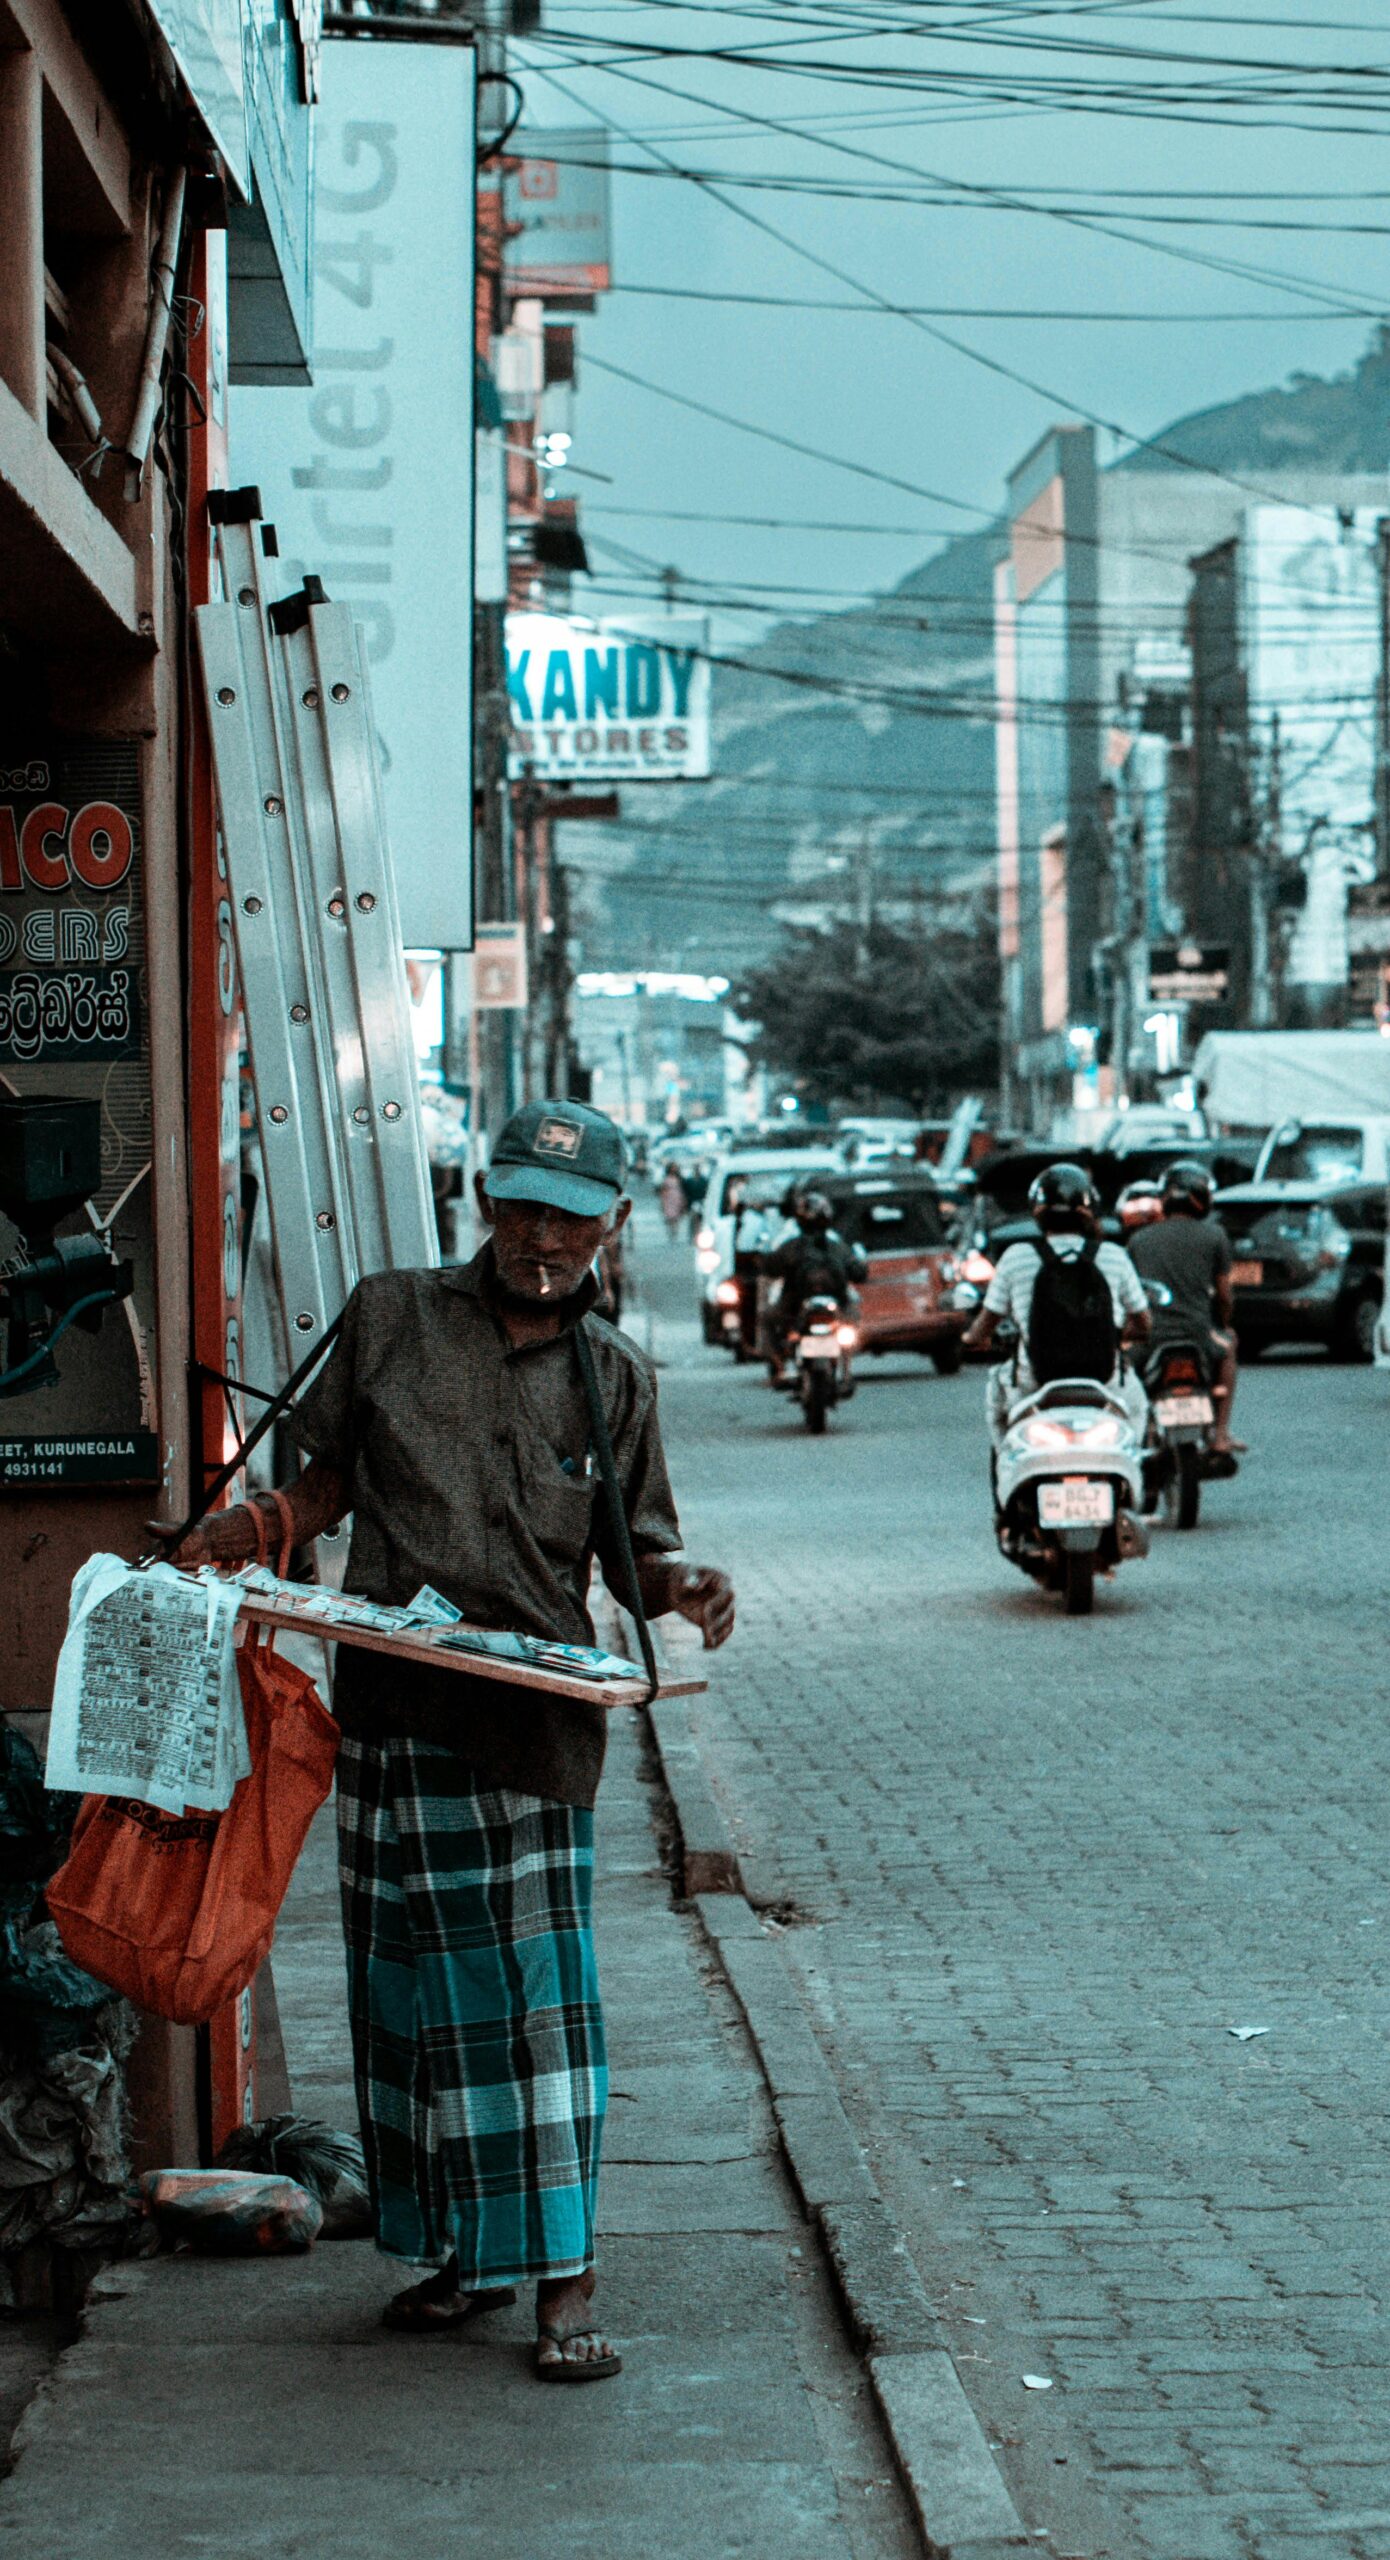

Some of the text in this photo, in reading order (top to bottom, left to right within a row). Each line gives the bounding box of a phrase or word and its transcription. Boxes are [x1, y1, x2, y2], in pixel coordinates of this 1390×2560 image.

[312, 121, 398, 310] 4G
[506, 645, 697, 721] KANDY
[4, 1462, 64, 1476] 4931141
[33, 1441, 135, 1457] KURUNEGALA
